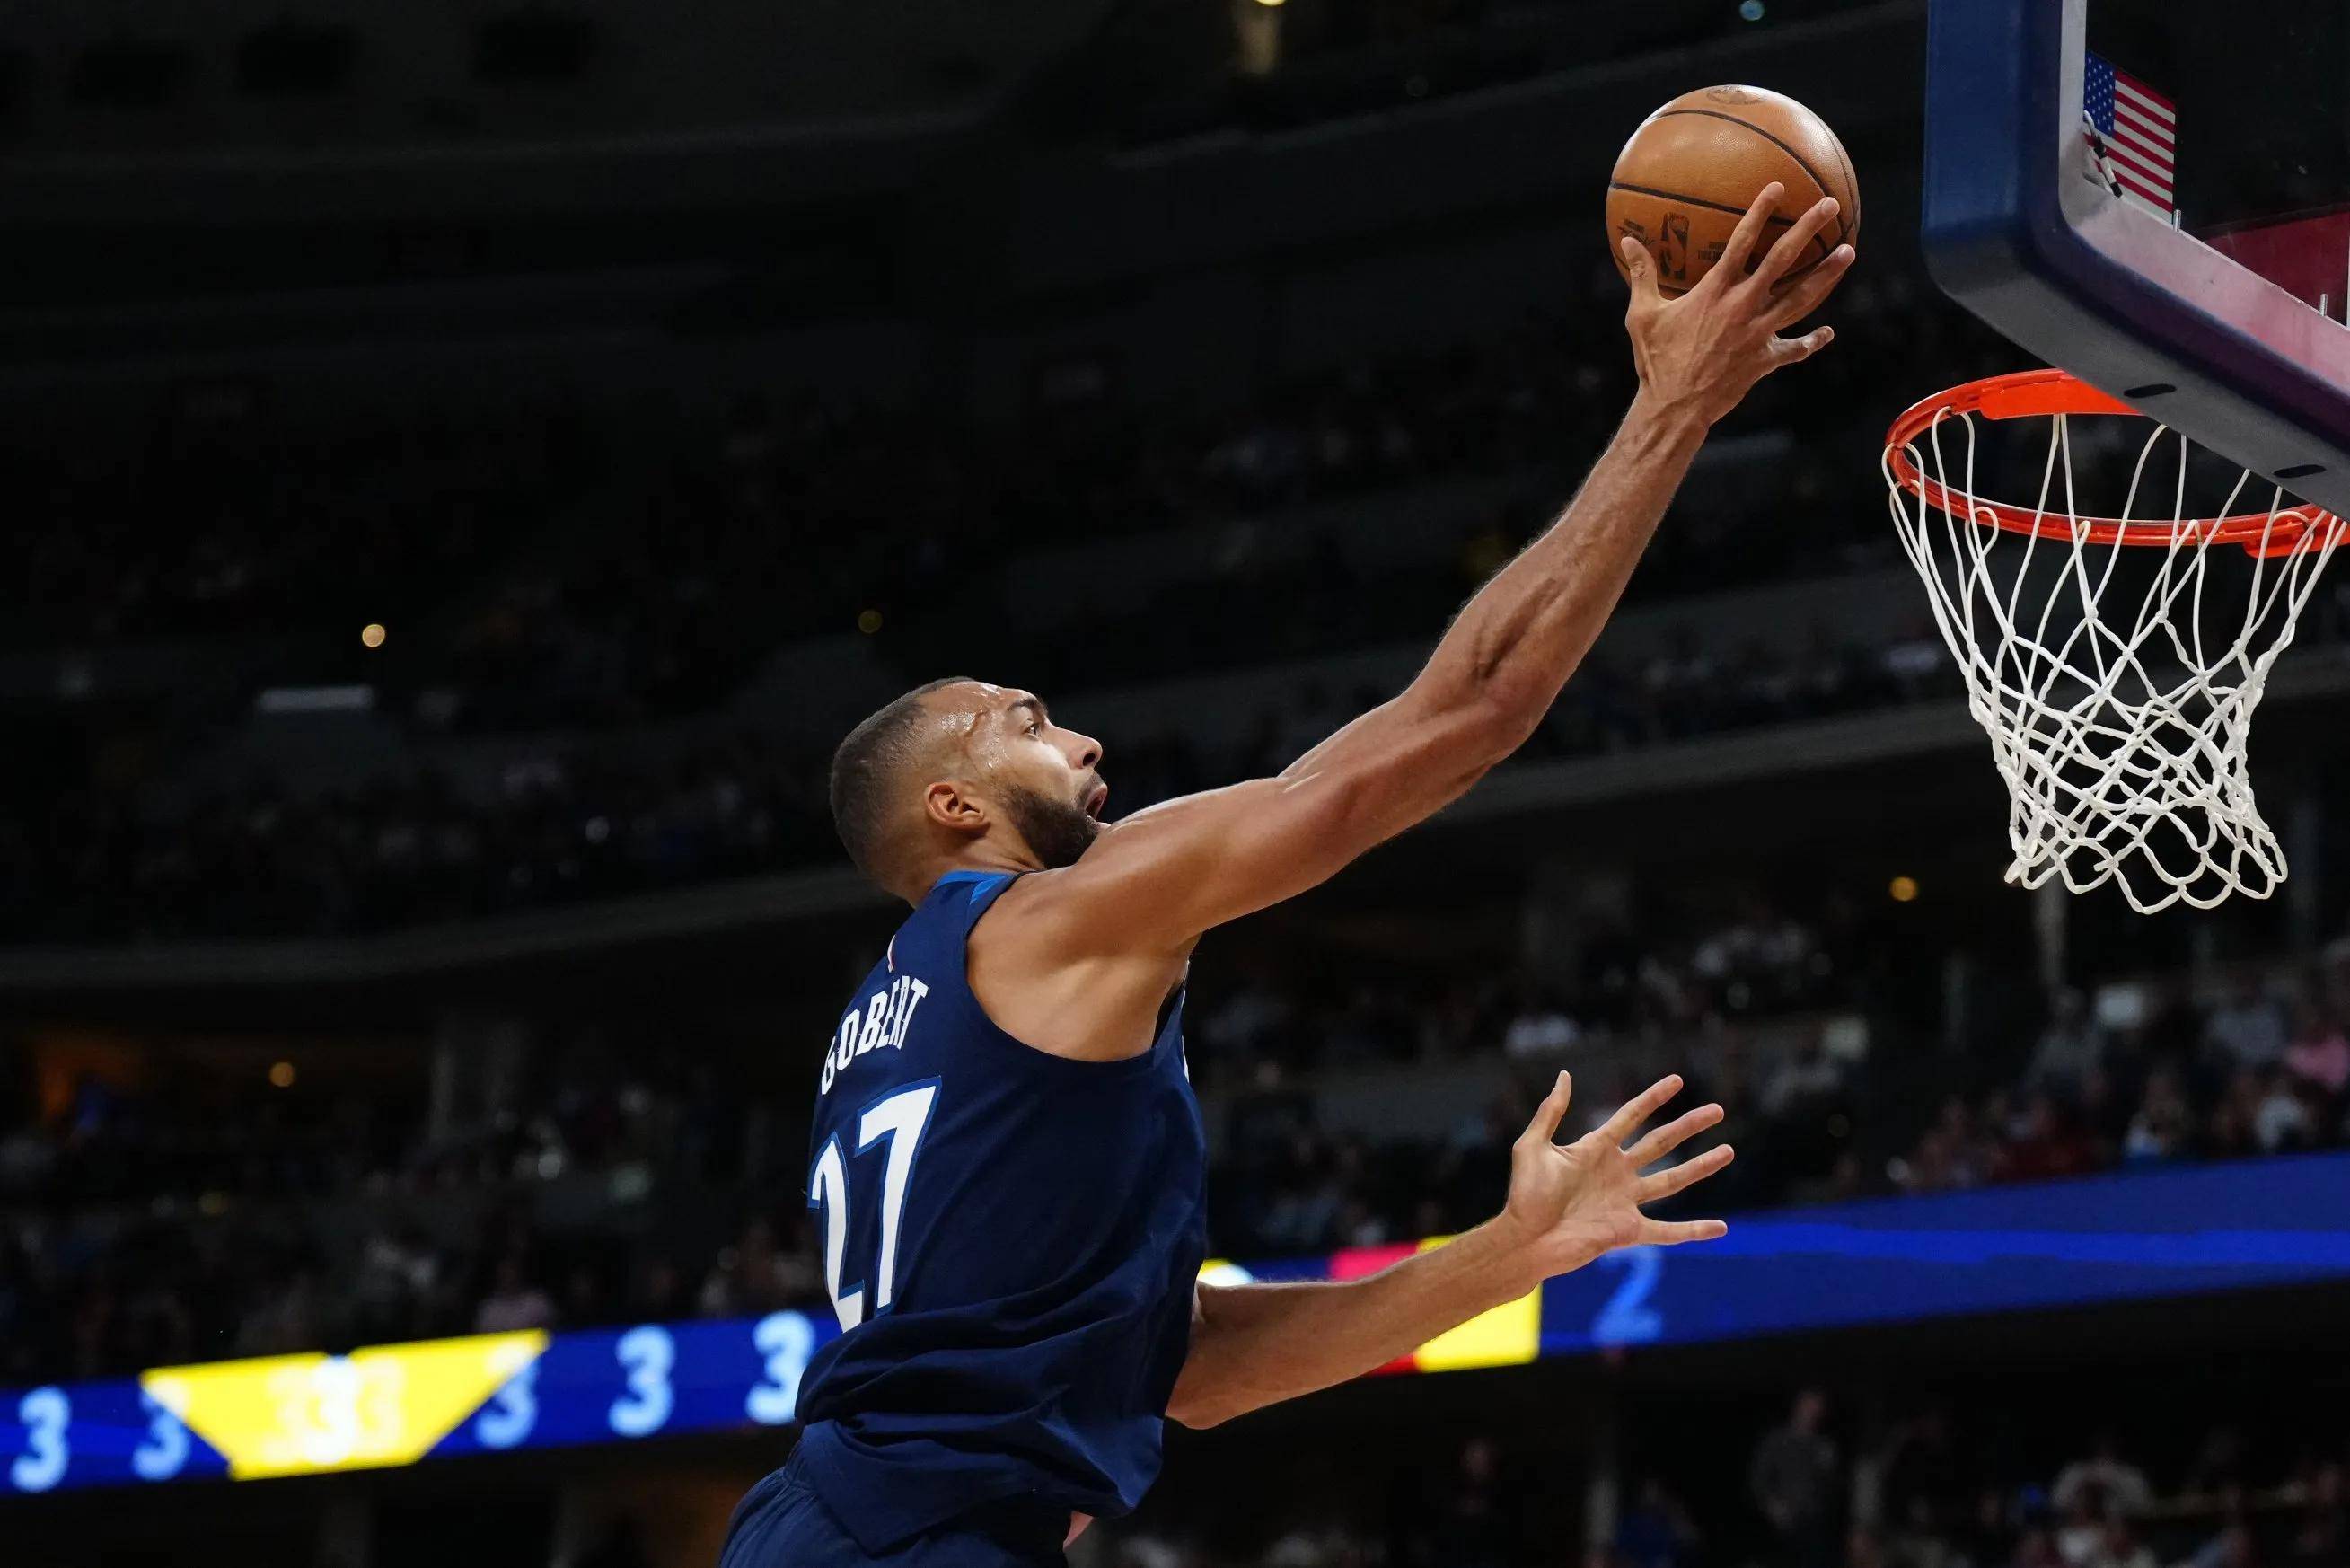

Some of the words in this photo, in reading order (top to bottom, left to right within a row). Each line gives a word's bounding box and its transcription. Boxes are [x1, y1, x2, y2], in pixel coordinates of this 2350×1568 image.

[821, 975, 929, 1095] GOBERT
[810, 1077, 939, 1334] 27
[1594, 1244, 1663, 1343] 2
[12, 1386, 71, 1493] 3
[610, 1324, 675, 1437] 3
[745, 1311, 815, 1424] 3
